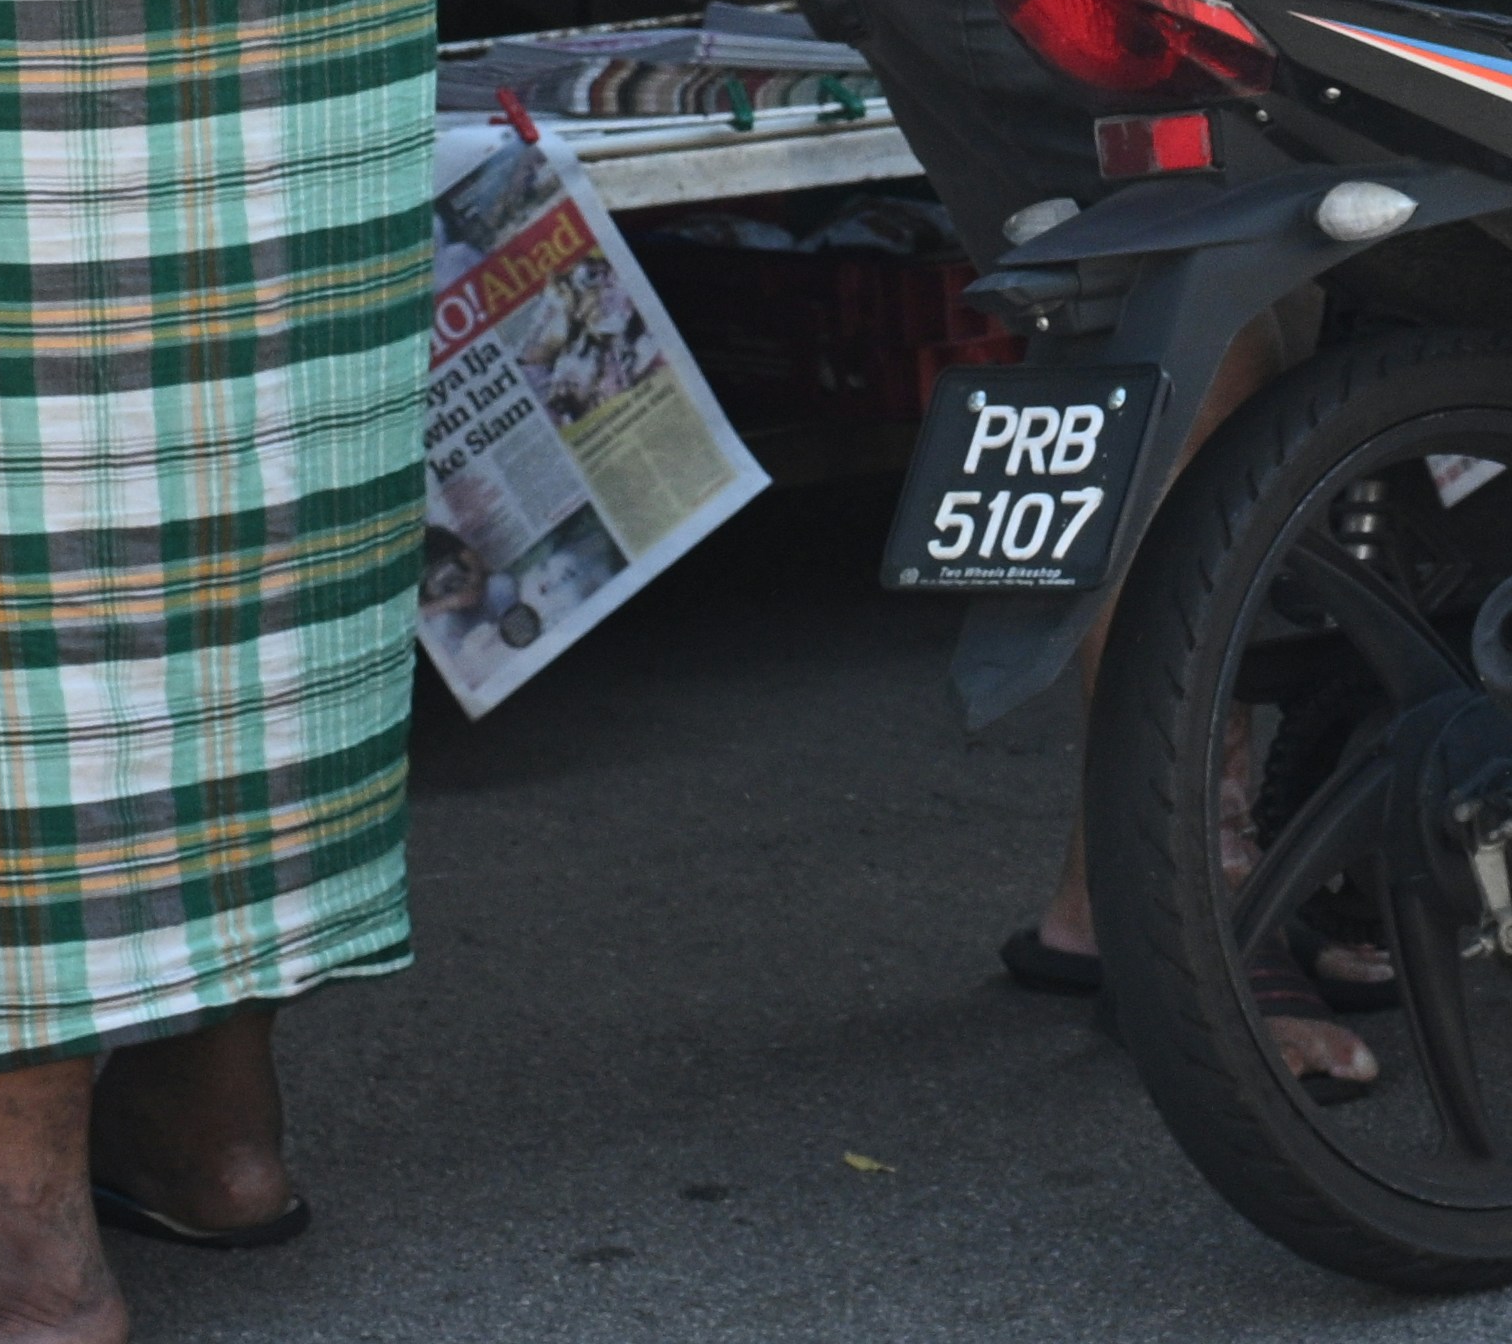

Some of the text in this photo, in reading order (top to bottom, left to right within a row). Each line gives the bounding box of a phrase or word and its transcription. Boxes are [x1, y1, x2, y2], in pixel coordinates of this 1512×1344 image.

[481, 214, 584, 311] Ahad
[464, 396, 535, 456] Siam
[963, 404, 1104, 476] PRB
[927, 487, 1104, 561] 5107
[939, 566, 962, 578] Two
